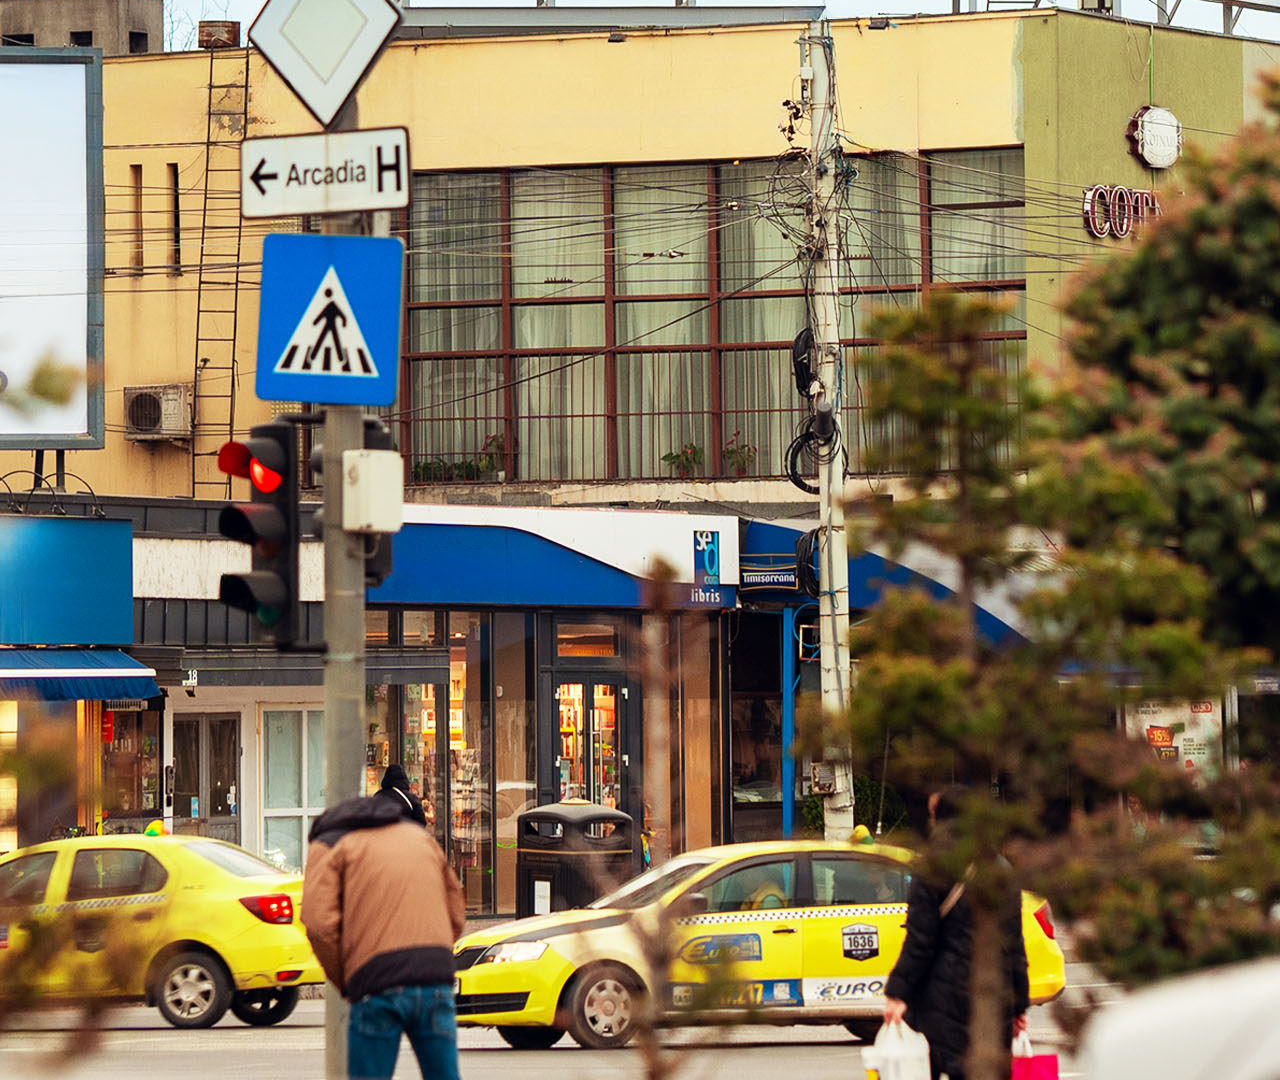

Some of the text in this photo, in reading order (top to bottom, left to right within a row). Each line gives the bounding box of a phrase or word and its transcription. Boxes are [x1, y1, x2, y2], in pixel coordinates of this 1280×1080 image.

[286, 145, 401, 192] Arcadia H
[691, 589, 720, 603] libris
[188, 670, 198, 681] 18
[847, 936, 874, 948] 1636
